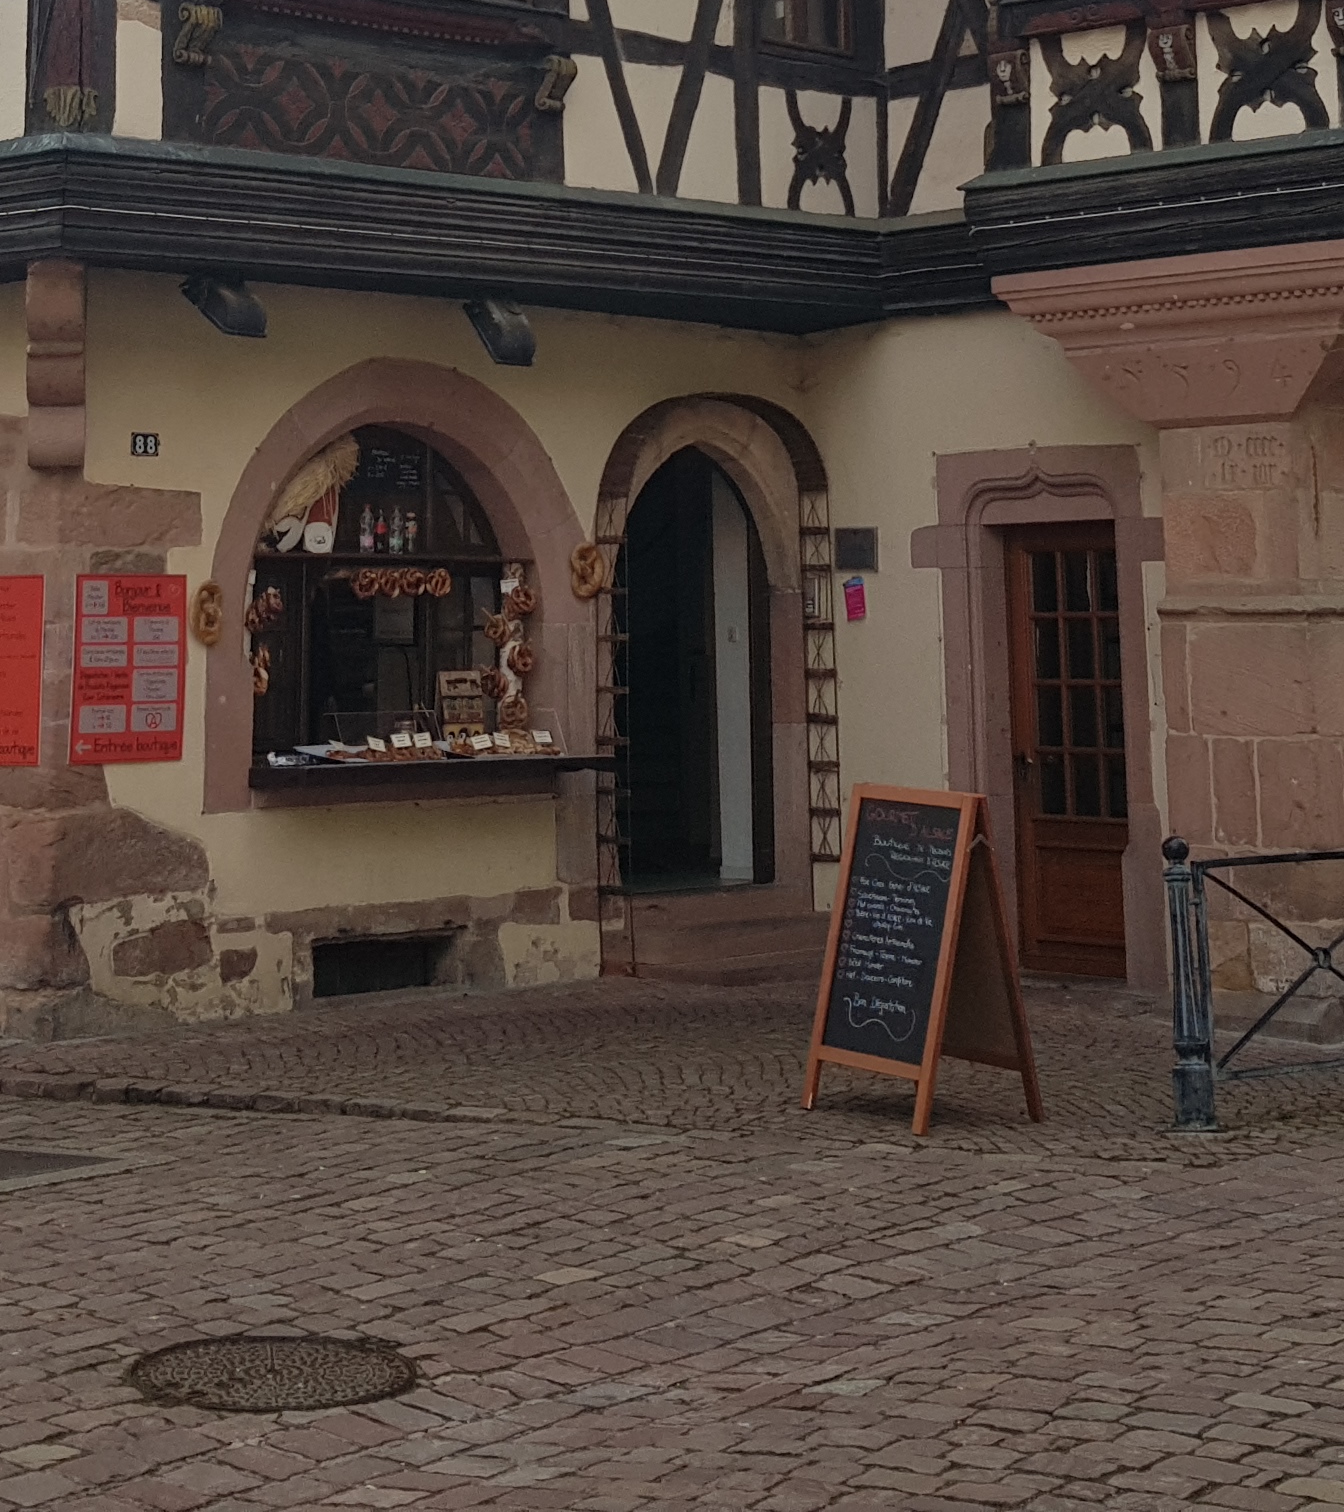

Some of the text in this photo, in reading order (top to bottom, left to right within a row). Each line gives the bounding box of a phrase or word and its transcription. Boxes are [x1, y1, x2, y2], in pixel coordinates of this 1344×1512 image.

[135, 435, 156, 454] 88
[114, 580, 151, 599] Bonjour
[123, 598, 170, 612] Bienvenue
[94, 735, 178, 755] Entrée boutique
